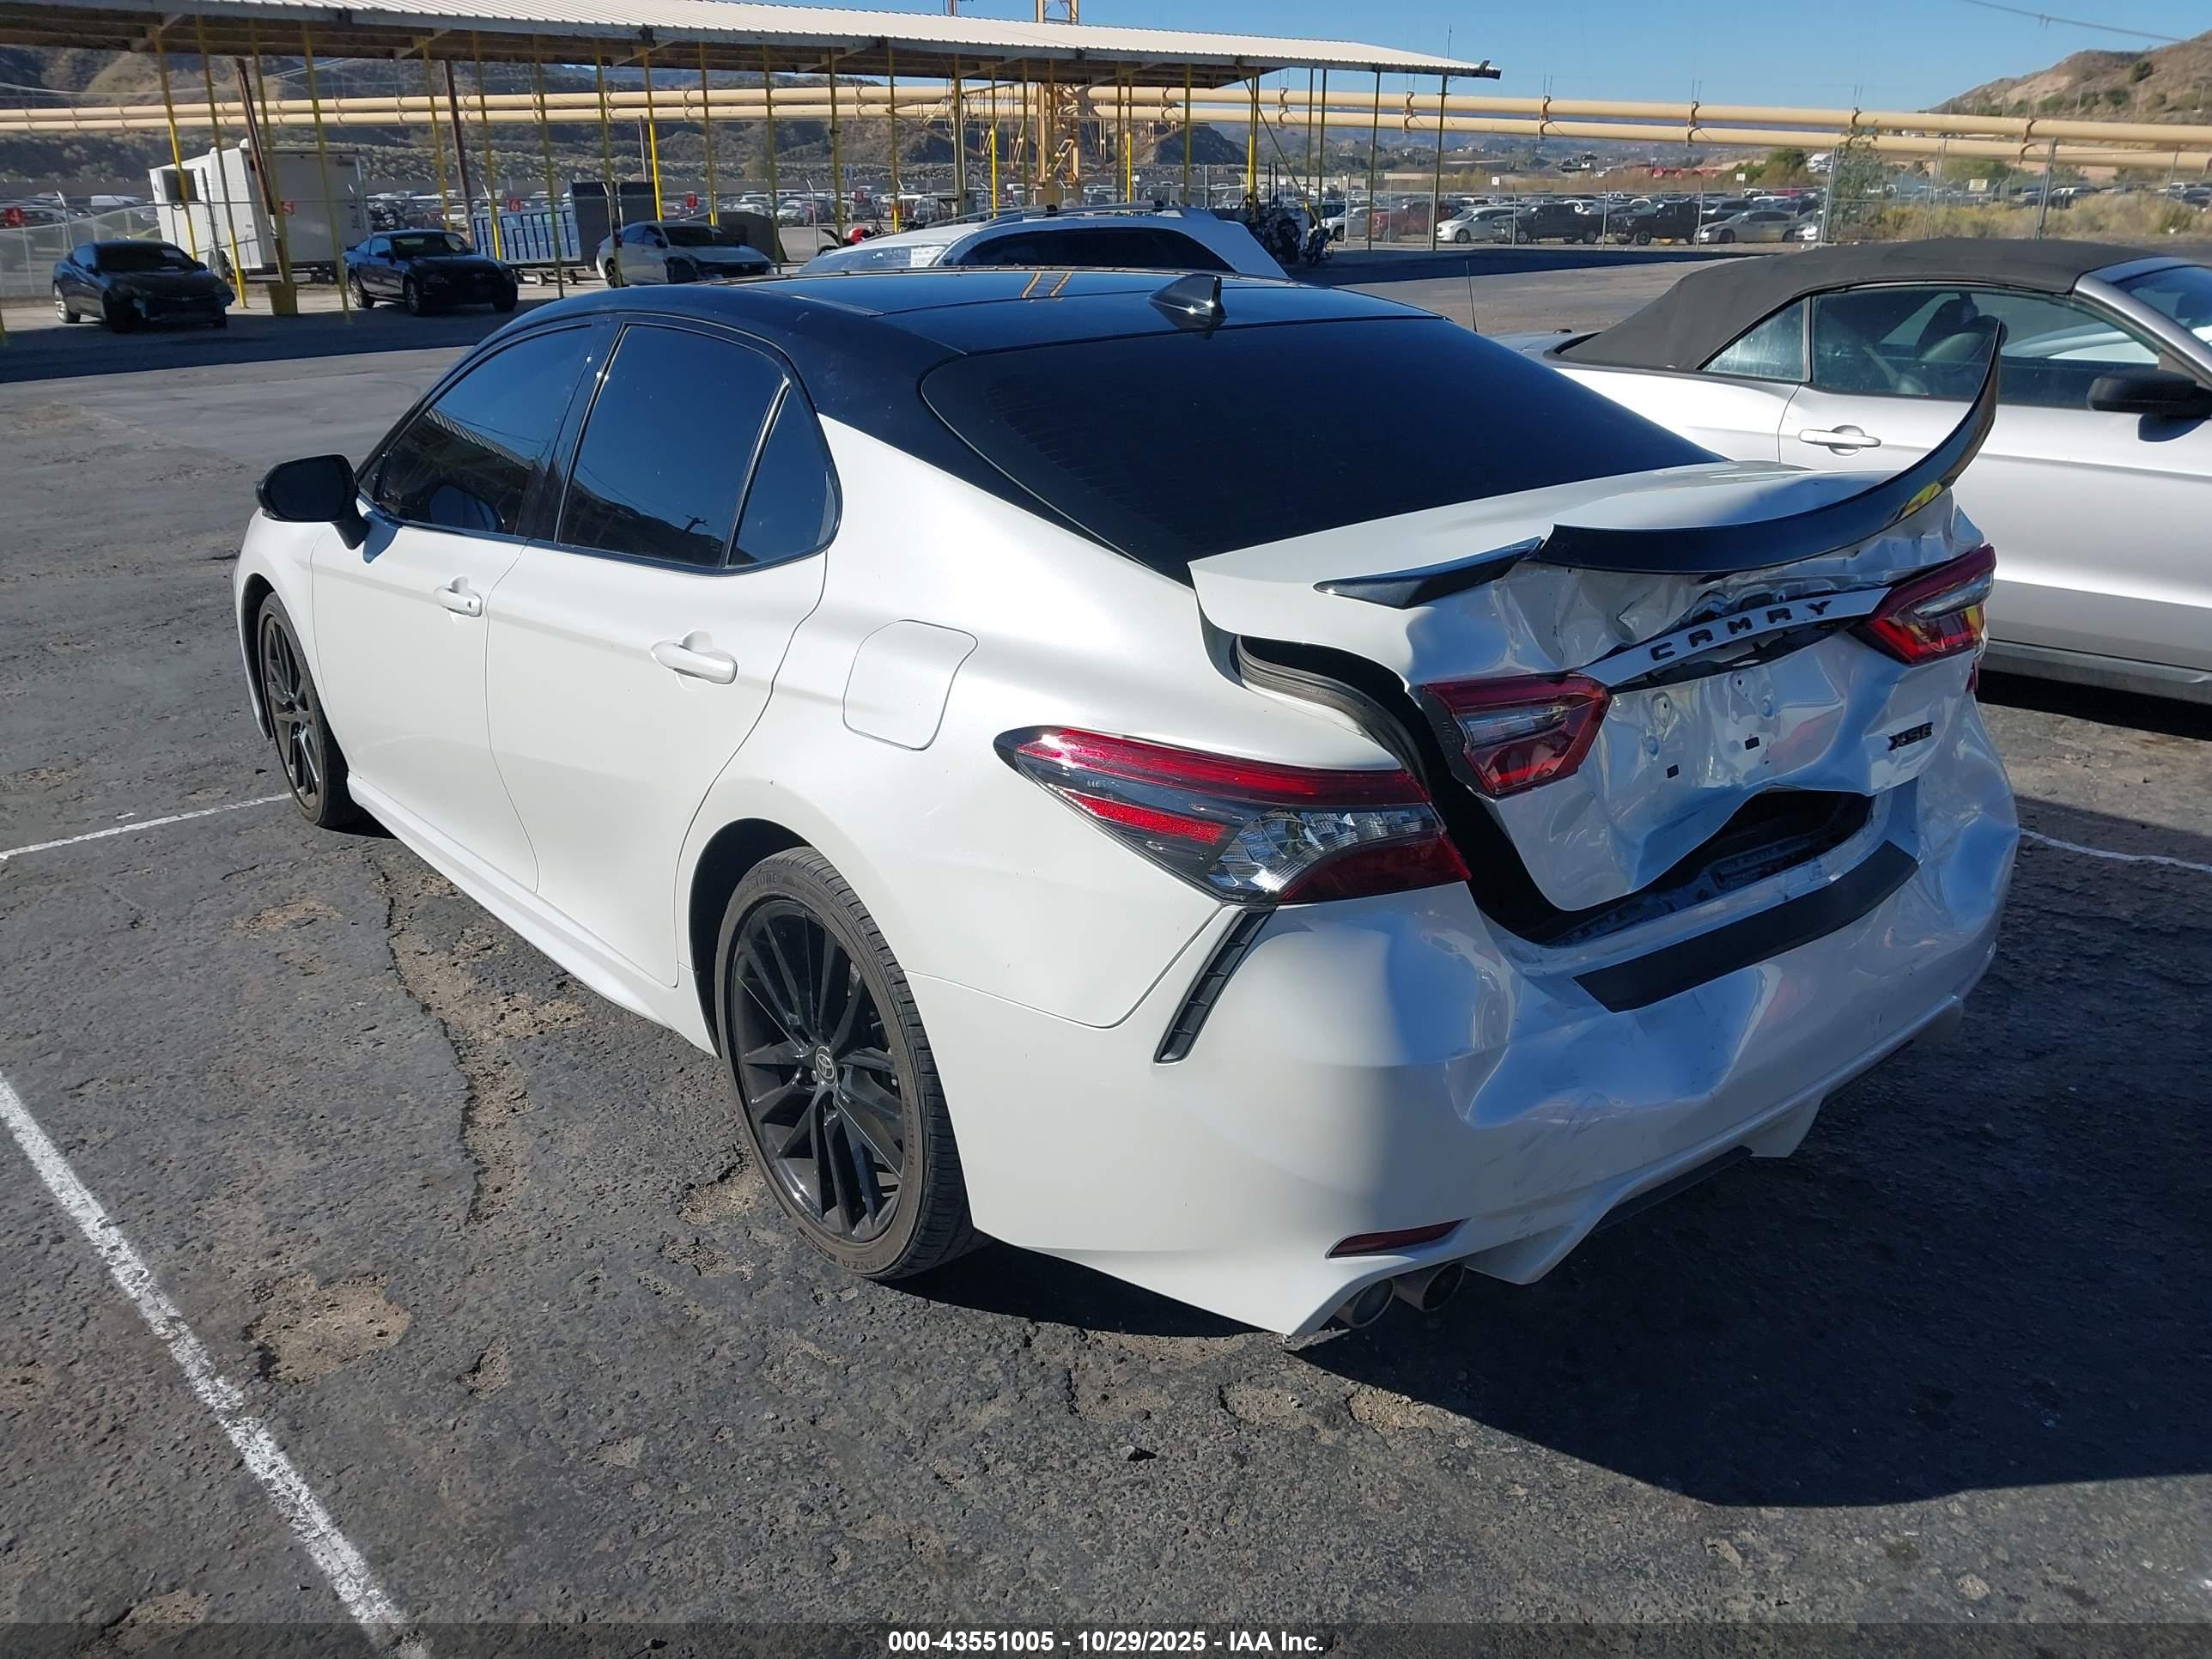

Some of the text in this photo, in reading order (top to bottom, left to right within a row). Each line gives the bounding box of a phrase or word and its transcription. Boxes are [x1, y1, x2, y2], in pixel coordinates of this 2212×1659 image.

[283, 199, 293, 214] 5
[510, 199, 520, 211] 6
[9, 208, 21, 223] 4
[1650, 600, 1832, 662] CAMRY
[1887, 722, 1934, 751] XSE
